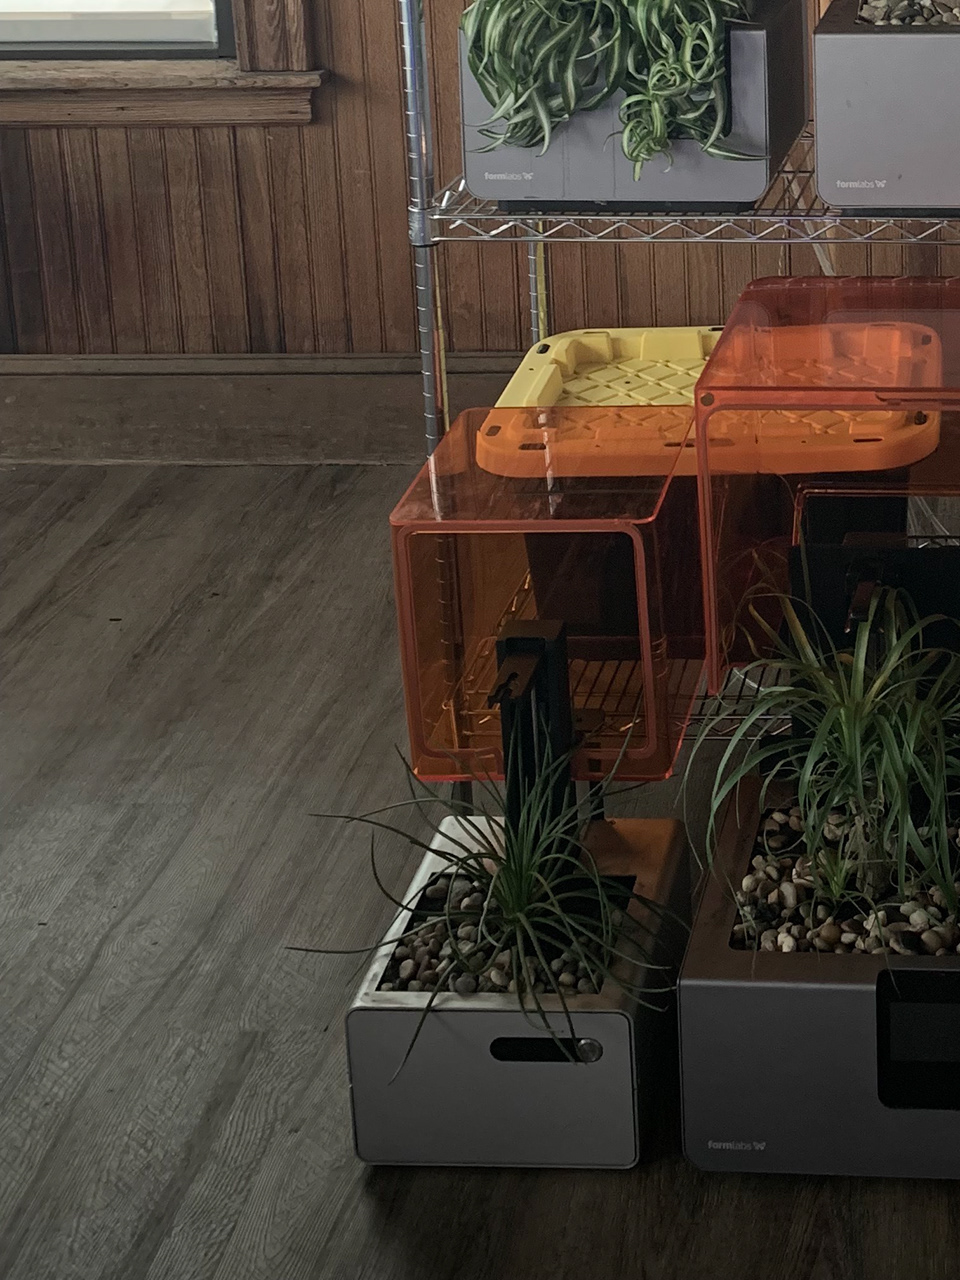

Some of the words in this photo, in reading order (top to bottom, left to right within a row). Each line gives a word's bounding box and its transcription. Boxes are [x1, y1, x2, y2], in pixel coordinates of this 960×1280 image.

[484, 172, 522, 181] formlabs
[836, 180, 875, 188] formlabs
[707, 1140, 752, 1150] formlabs
